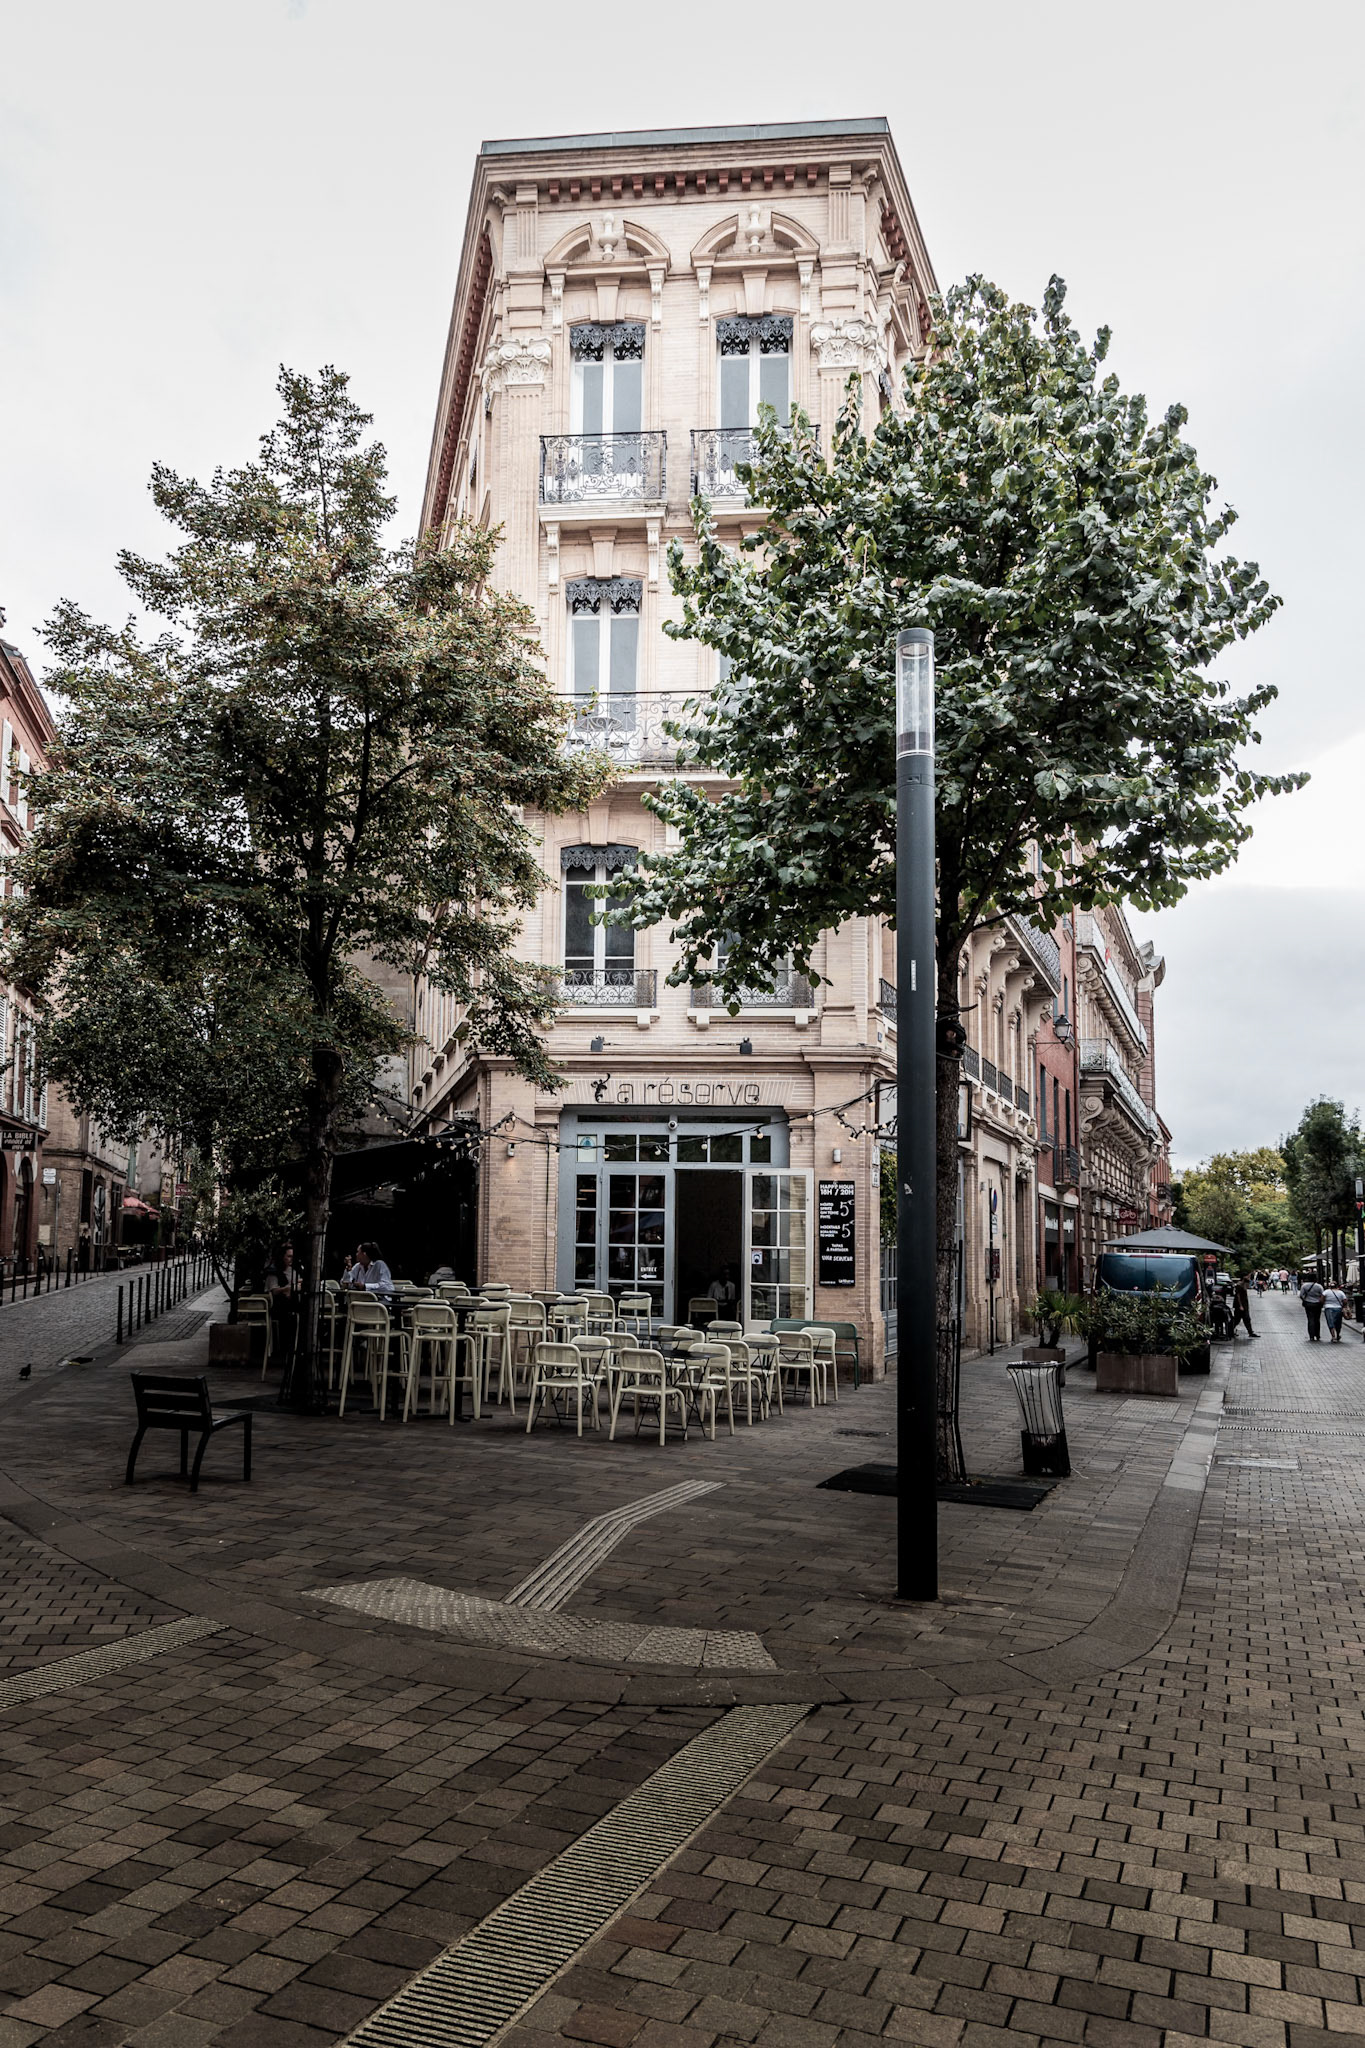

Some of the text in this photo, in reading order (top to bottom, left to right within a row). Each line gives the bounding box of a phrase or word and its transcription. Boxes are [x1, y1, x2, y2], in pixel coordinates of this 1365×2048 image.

[591, 1073, 760, 1105] La réserve
[14, 1132, 34, 1140] BIBLE
